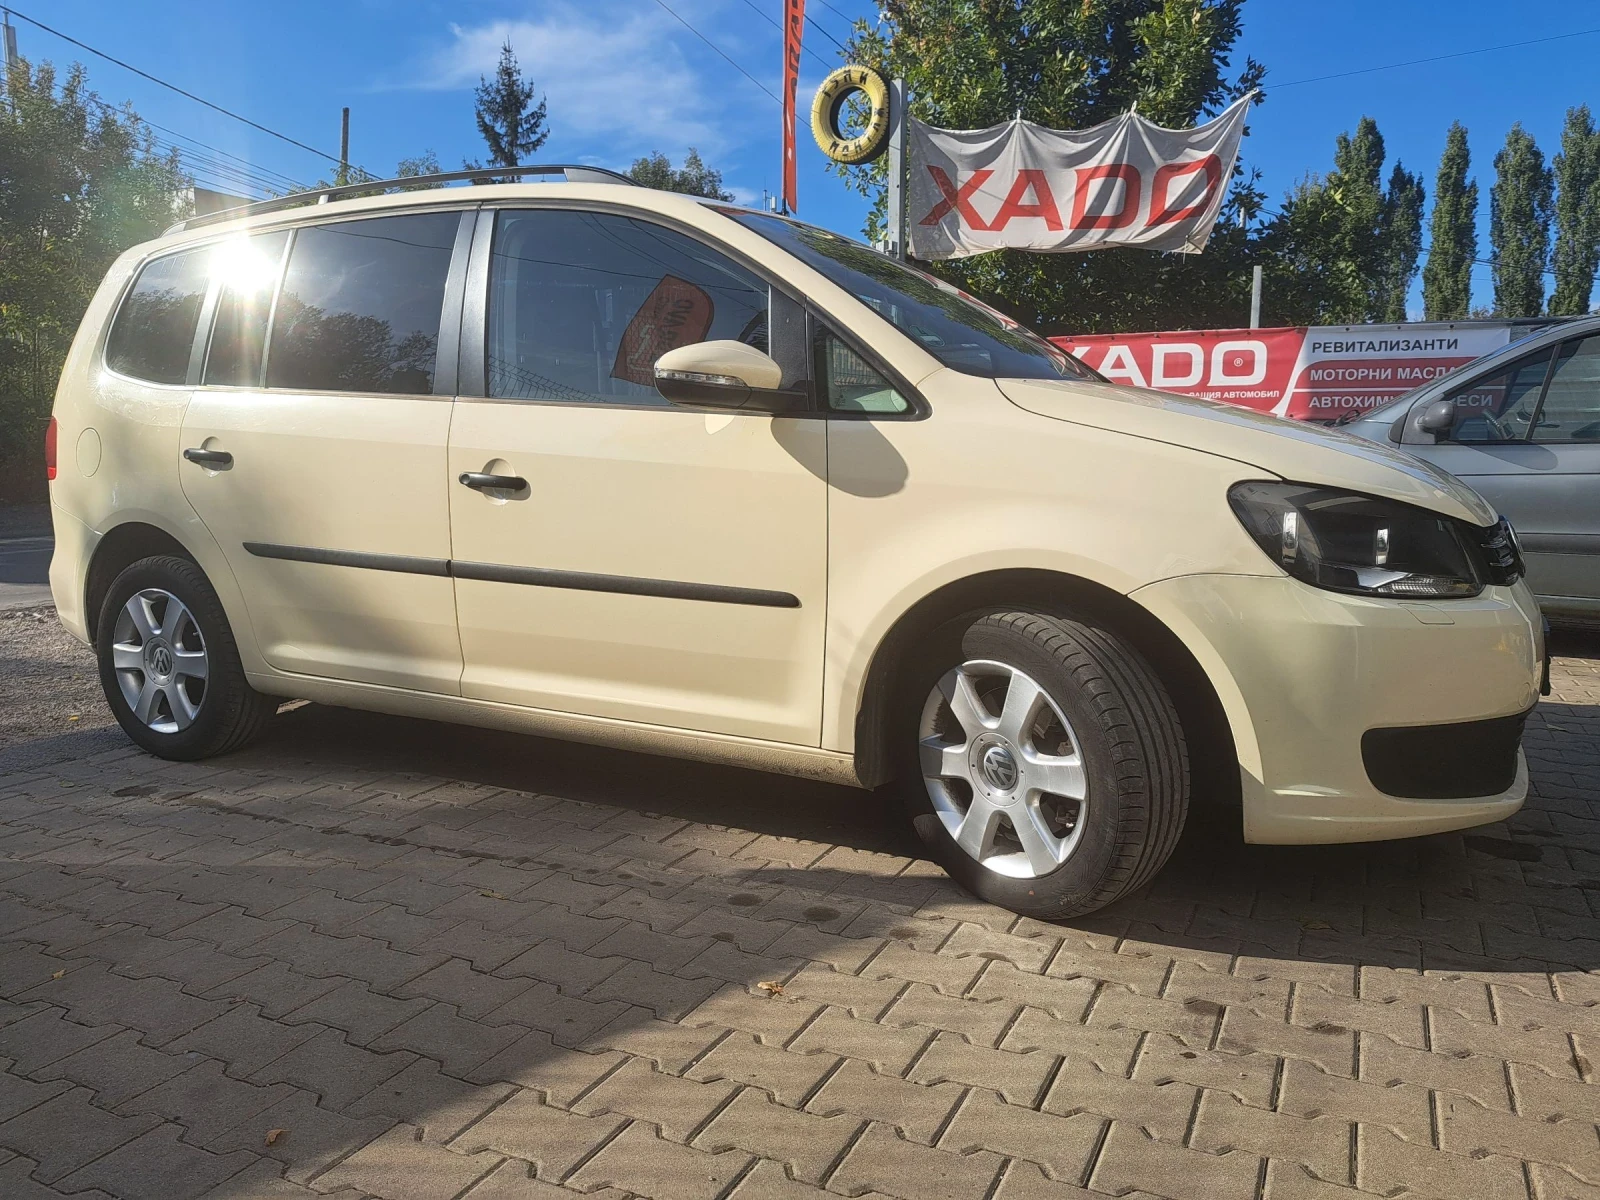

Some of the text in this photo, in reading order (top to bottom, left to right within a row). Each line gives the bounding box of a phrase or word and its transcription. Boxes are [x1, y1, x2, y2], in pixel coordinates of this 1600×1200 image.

[918, 154, 1222, 231] XADO
[1312, 338, 1458, 353] РЕВИТАЛИЗАНТИ
[1310, 368, 1392, 381] МОТОРНИ
[1222, 390, 1279, 399] АВТОМОБИЛ
[1308, 395, 1395, 408] АВТОХИМ
